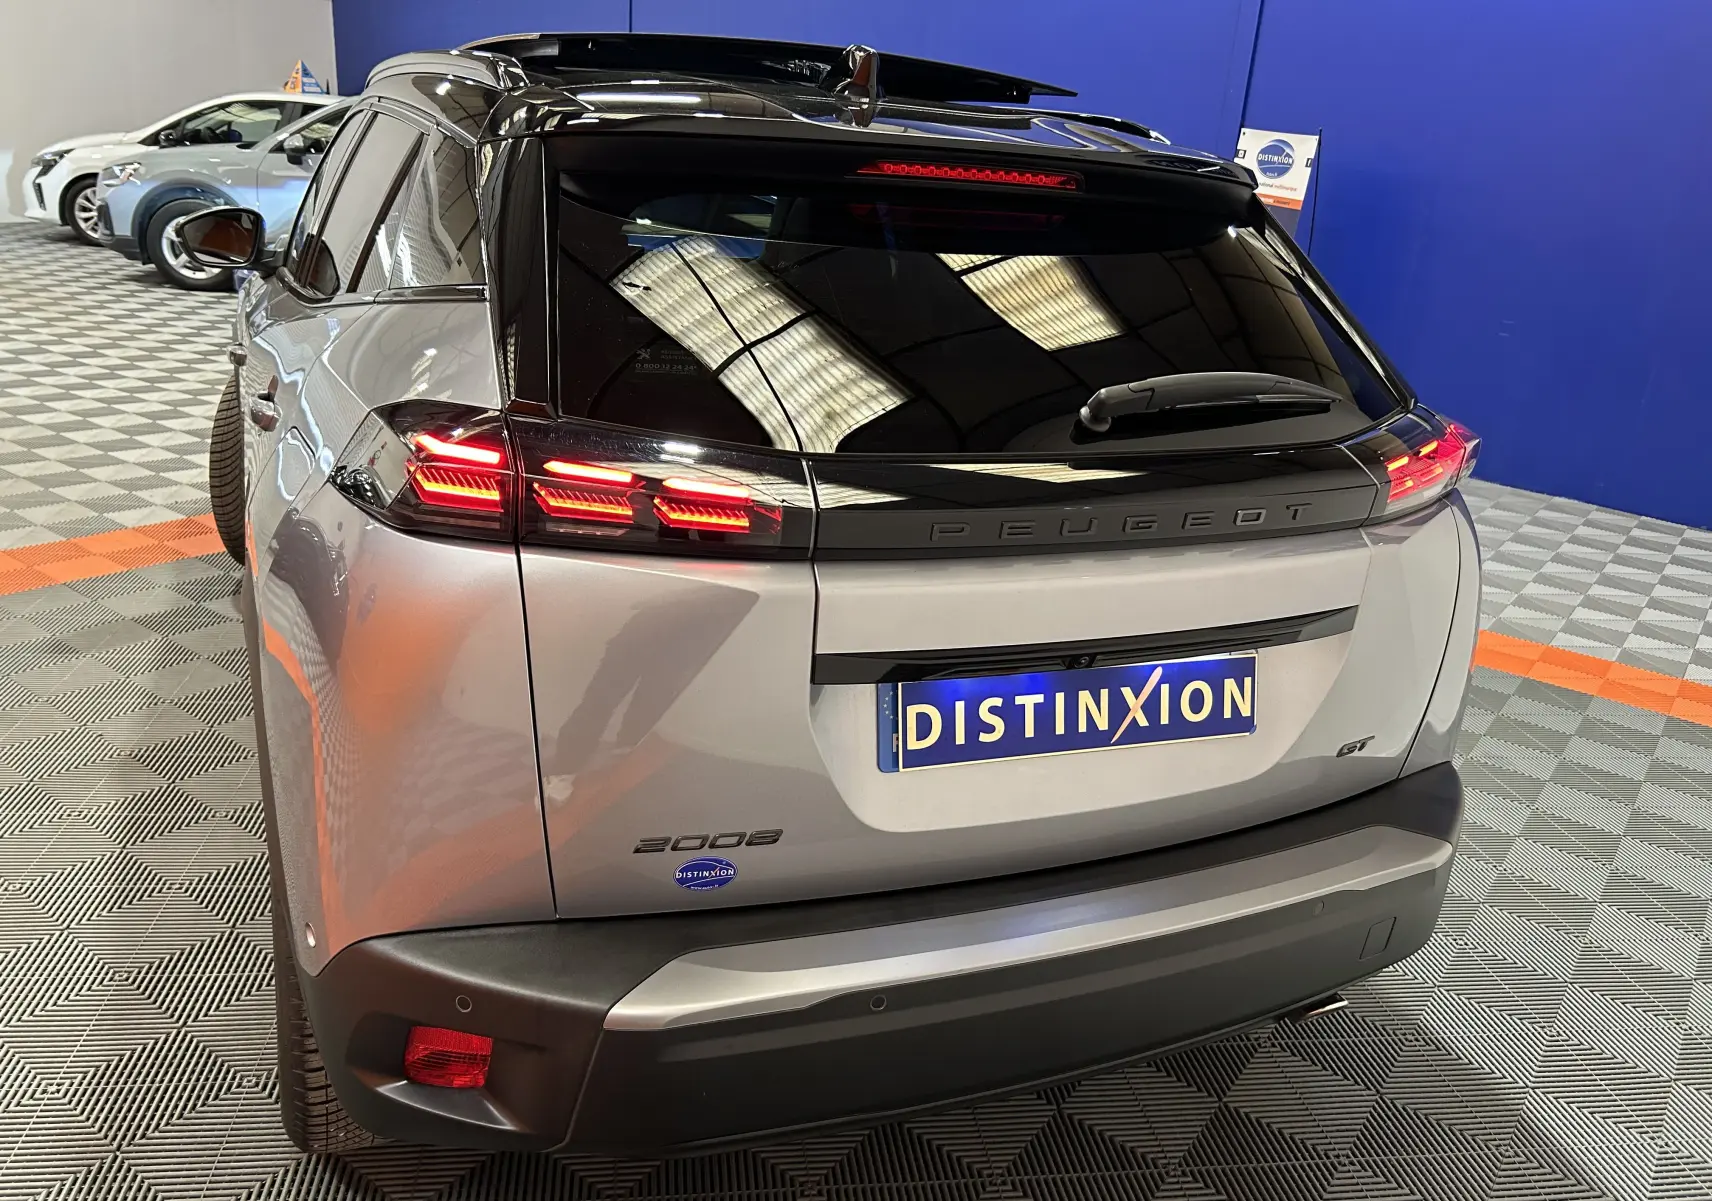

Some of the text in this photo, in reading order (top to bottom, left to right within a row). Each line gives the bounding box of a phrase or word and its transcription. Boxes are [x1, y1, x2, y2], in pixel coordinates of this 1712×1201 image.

[1258, 152, 1294, 165] DISTINXION
[930, 502, 1312, 542] PEUGEOT
[905, 666, 1252, 751] DISTINXION
[1336, 735, 1375, 757] GT
[633, 829, 783, 853] 2008
[676, 867, 734, 879] DISTINXION
